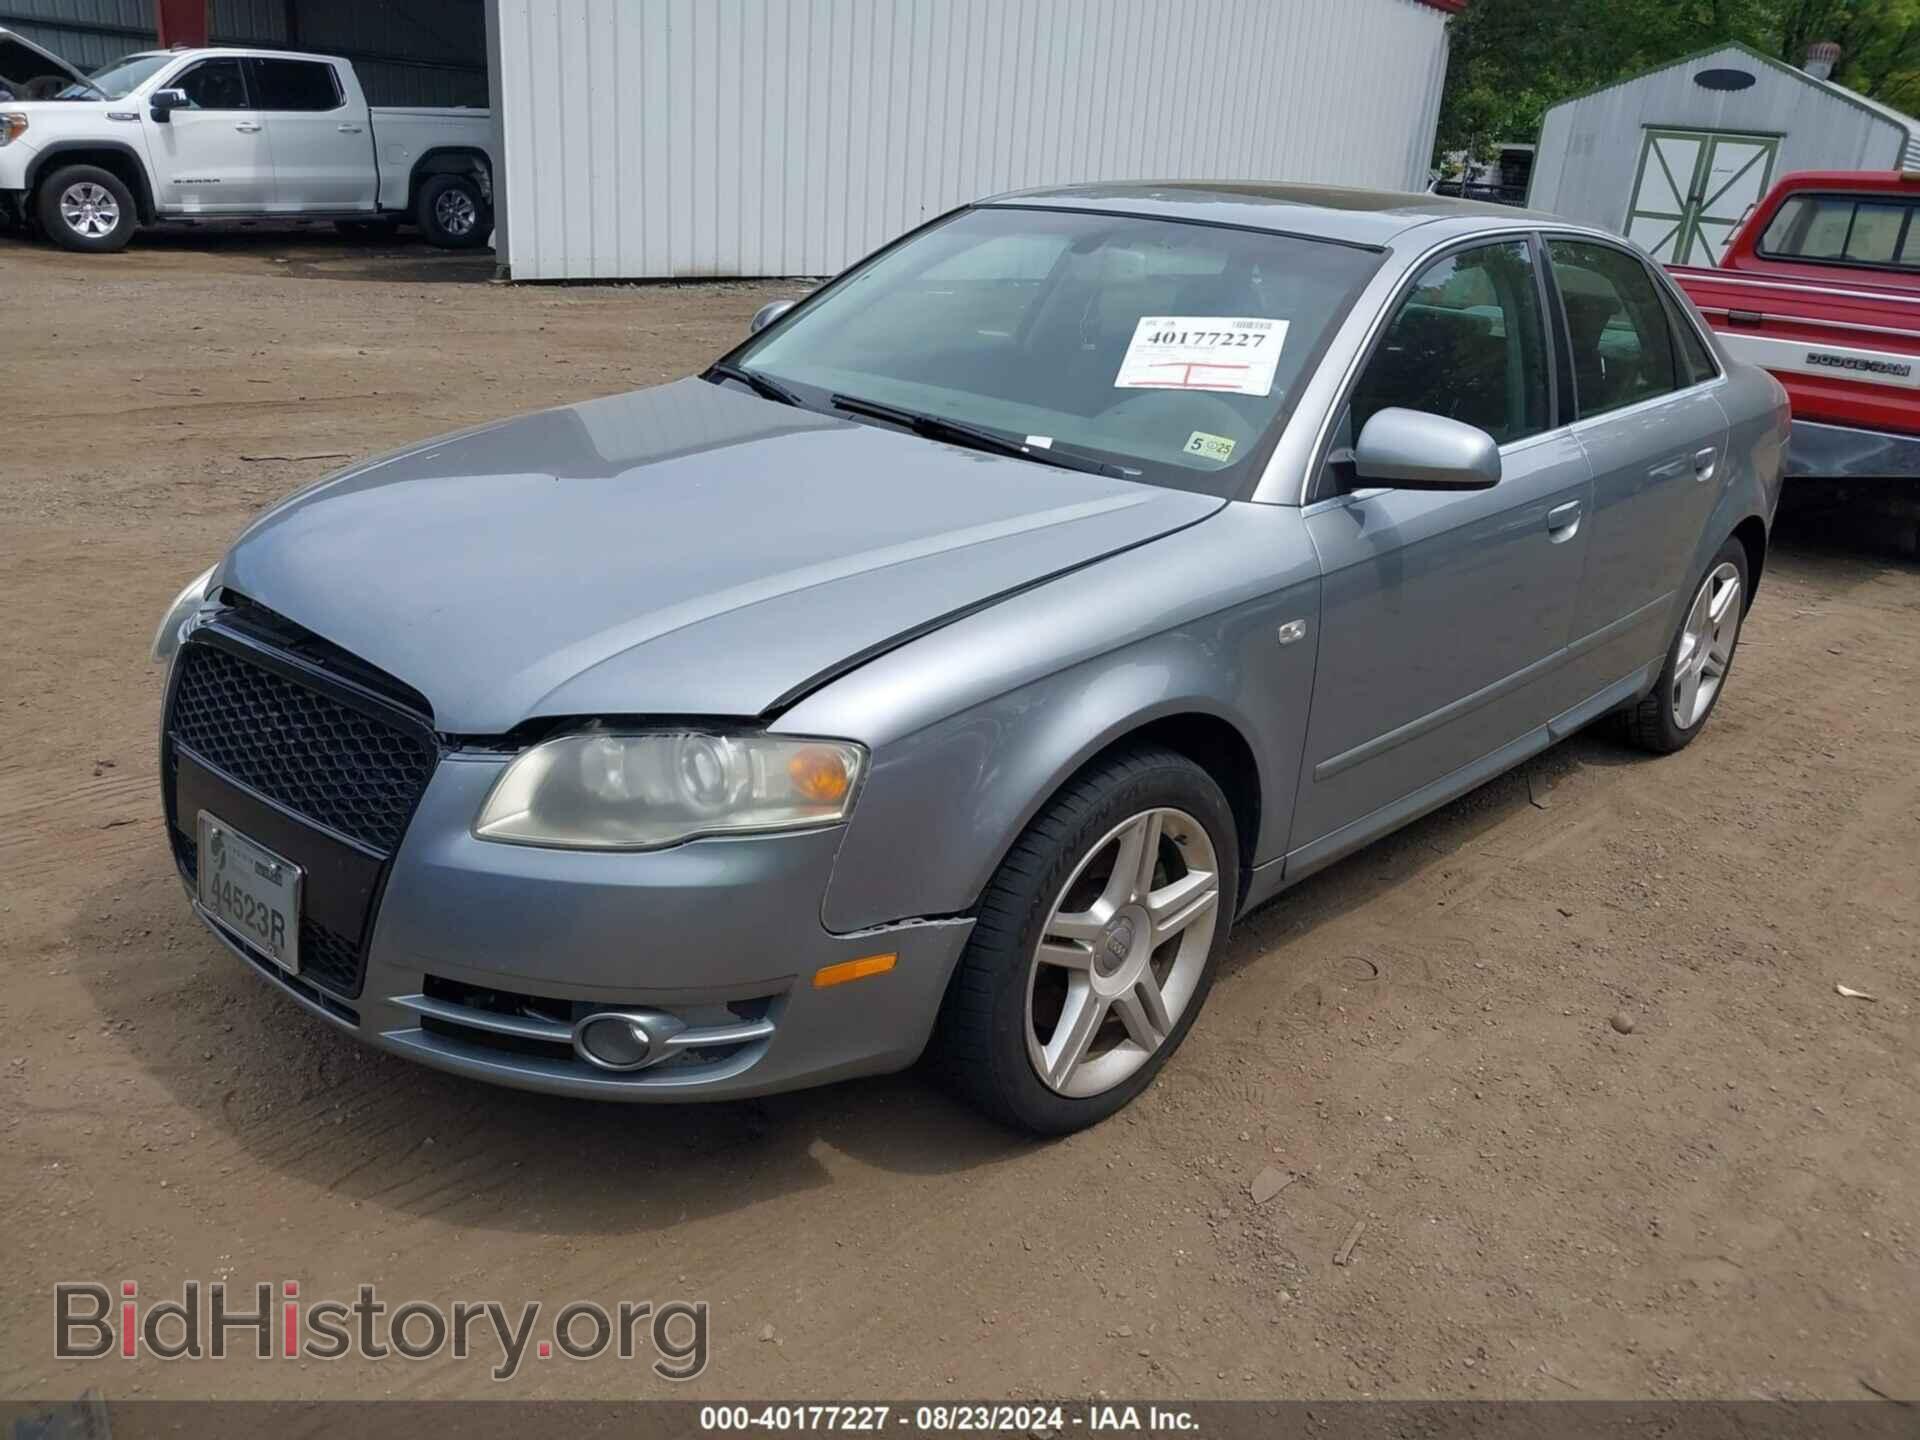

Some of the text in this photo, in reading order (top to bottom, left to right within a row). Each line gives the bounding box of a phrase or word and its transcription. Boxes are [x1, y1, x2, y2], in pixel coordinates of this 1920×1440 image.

[1146, 331, 1267, 348] 40177227
[1191, 437, 1232, 454] 5 25
[211, 872, 285, 950] 44523R
